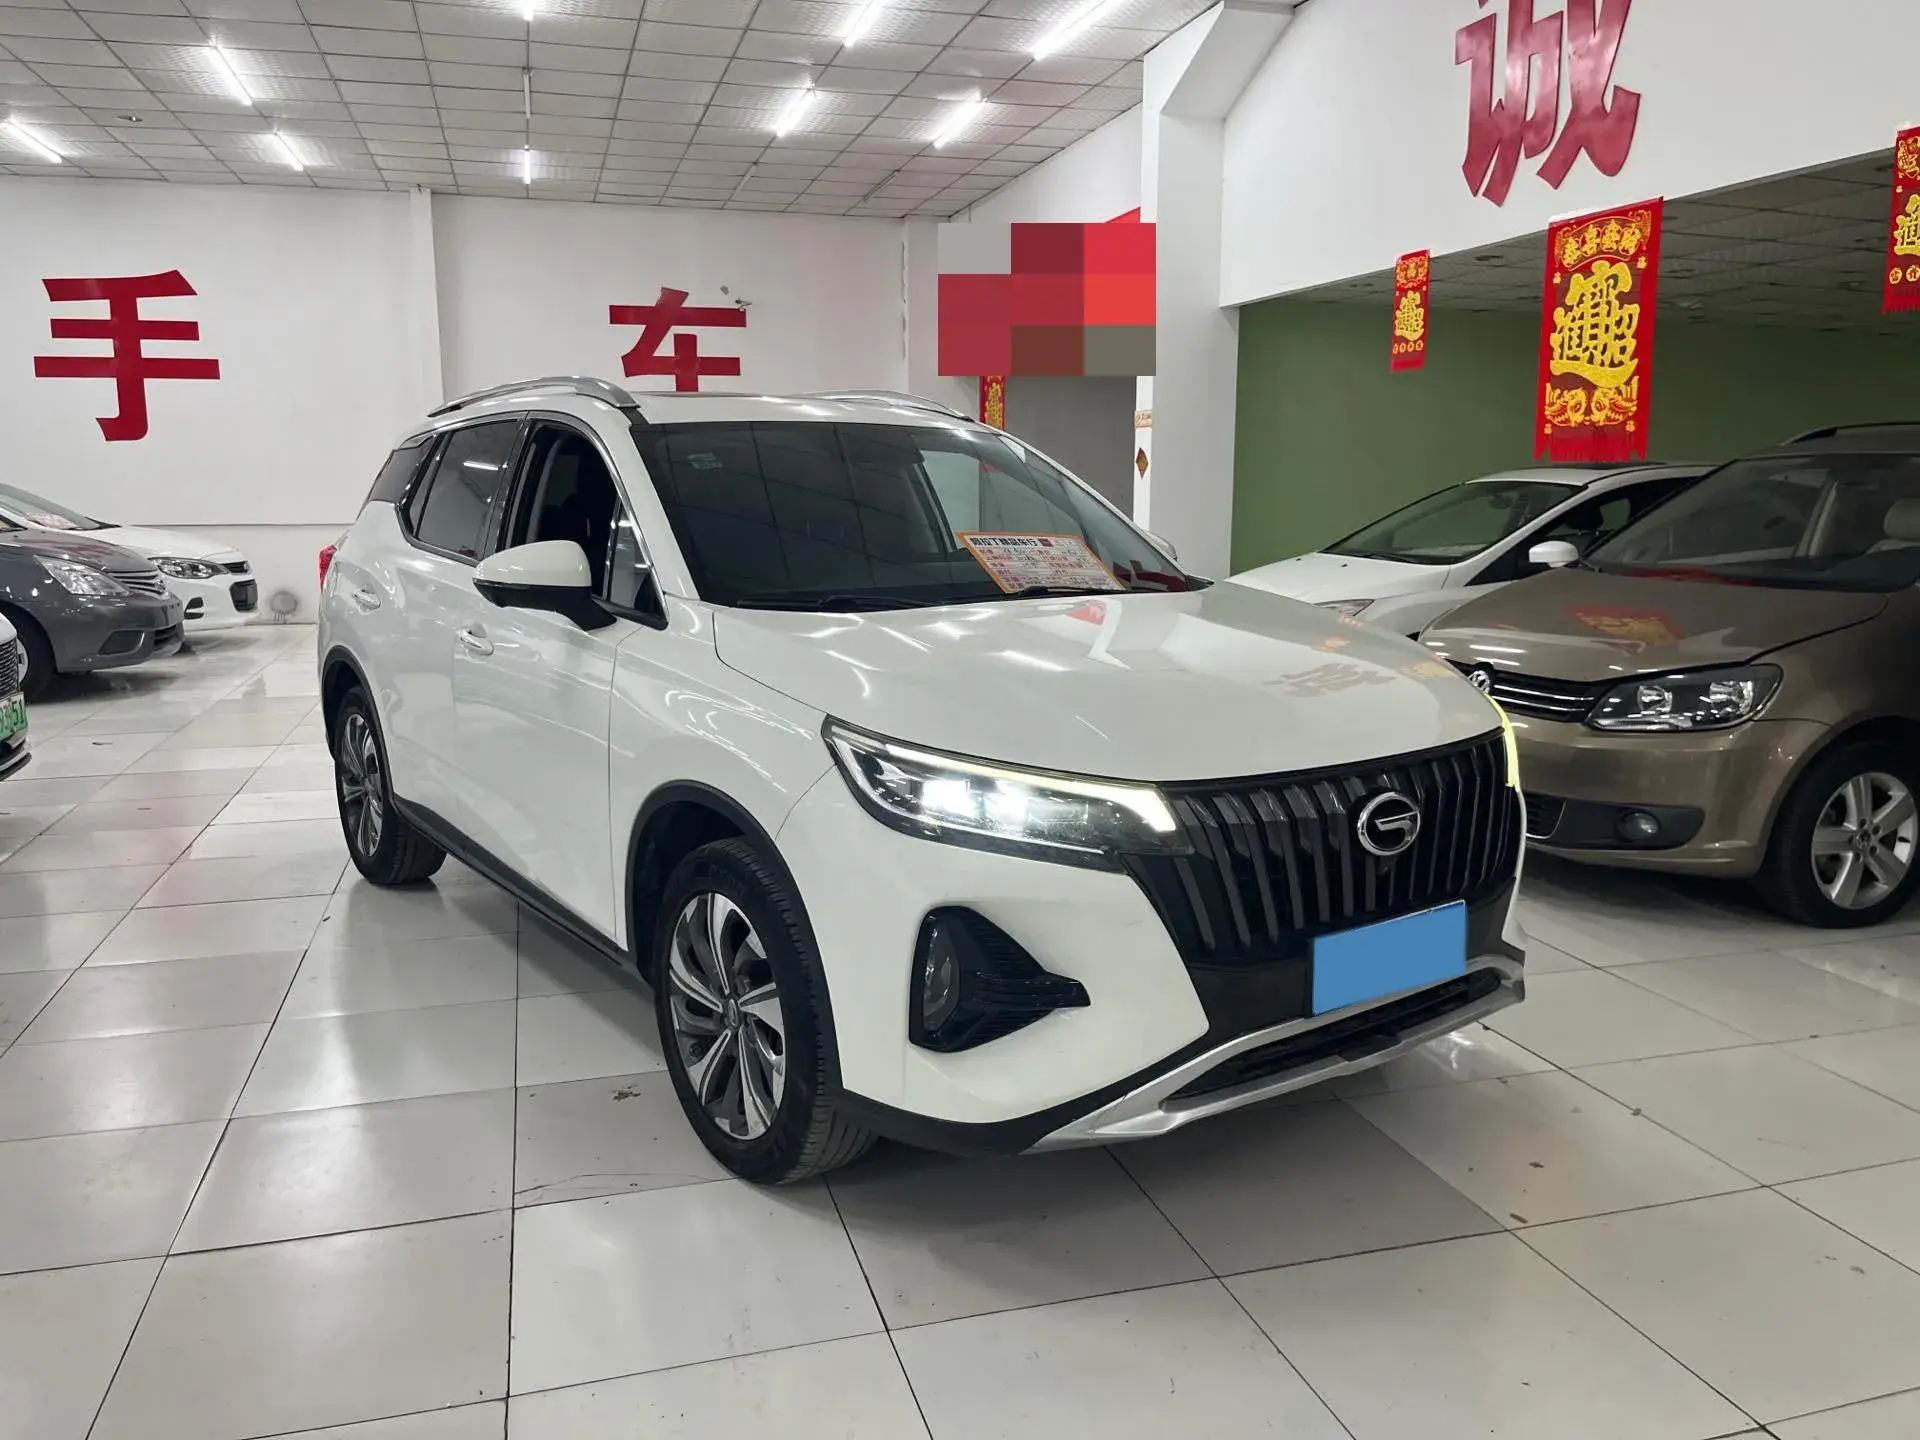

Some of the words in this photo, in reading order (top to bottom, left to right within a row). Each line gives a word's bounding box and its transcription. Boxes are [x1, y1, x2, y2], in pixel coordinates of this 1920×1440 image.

[1455, 0, 1641, 207] 诚
[34, 270, 221, 442] 手
[609, 286, 747, 393] 车
